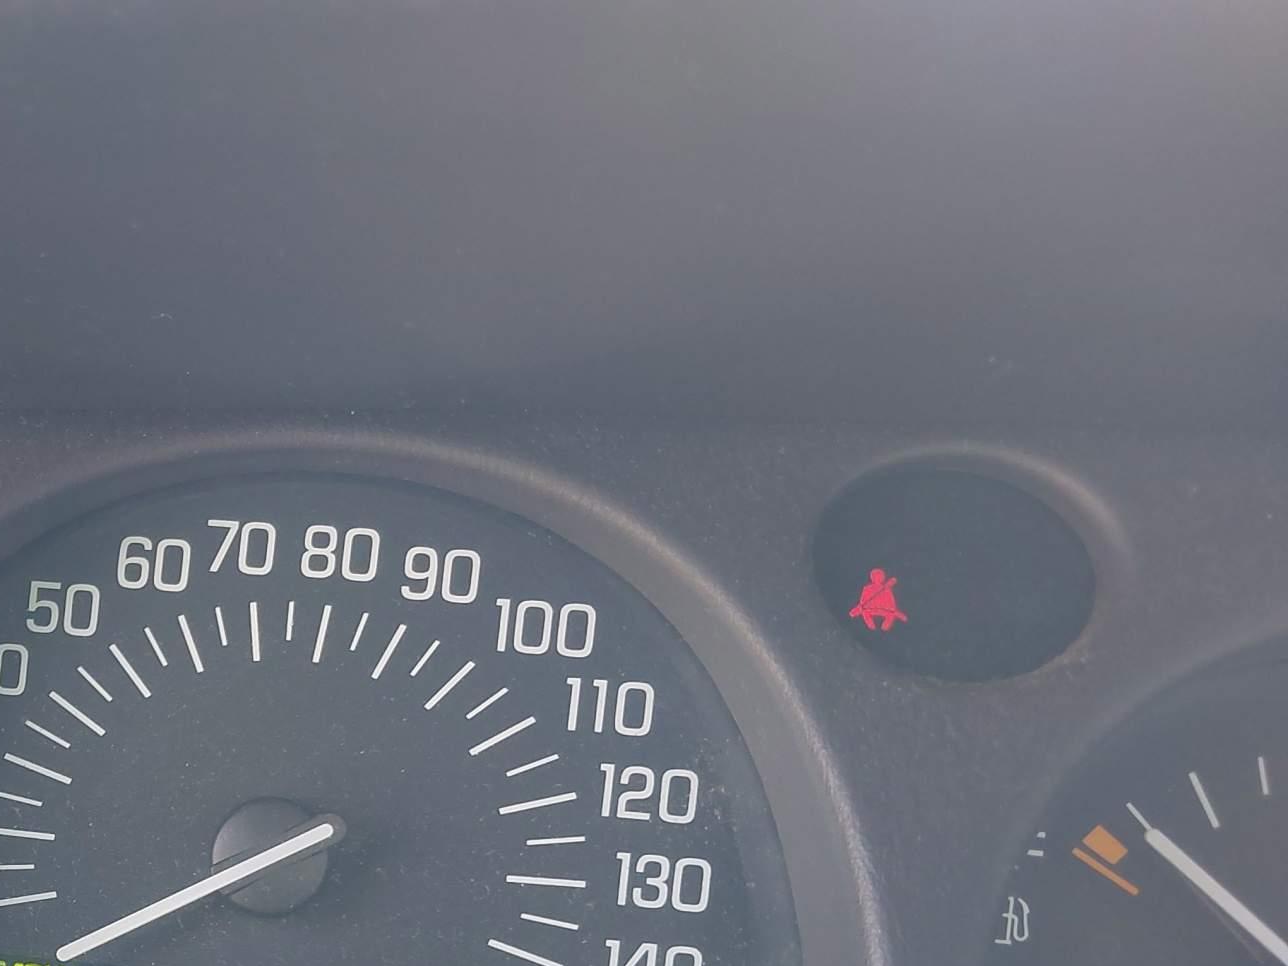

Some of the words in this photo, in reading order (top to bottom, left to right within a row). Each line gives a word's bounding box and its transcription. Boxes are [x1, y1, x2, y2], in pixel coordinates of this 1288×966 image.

[117, 535, 192, 592] 60
[208, 519, 276, 576] 70
[301, 524, 380, 582] 80
[400, 546, 481, 604] 90
[26, 580, 100, 637] 50
[496, 598, 597, 658] 100
[567, 677, 655, 737] 110
[601, 763, 700, 824] 120
[617, 852, 712, 913] 130
